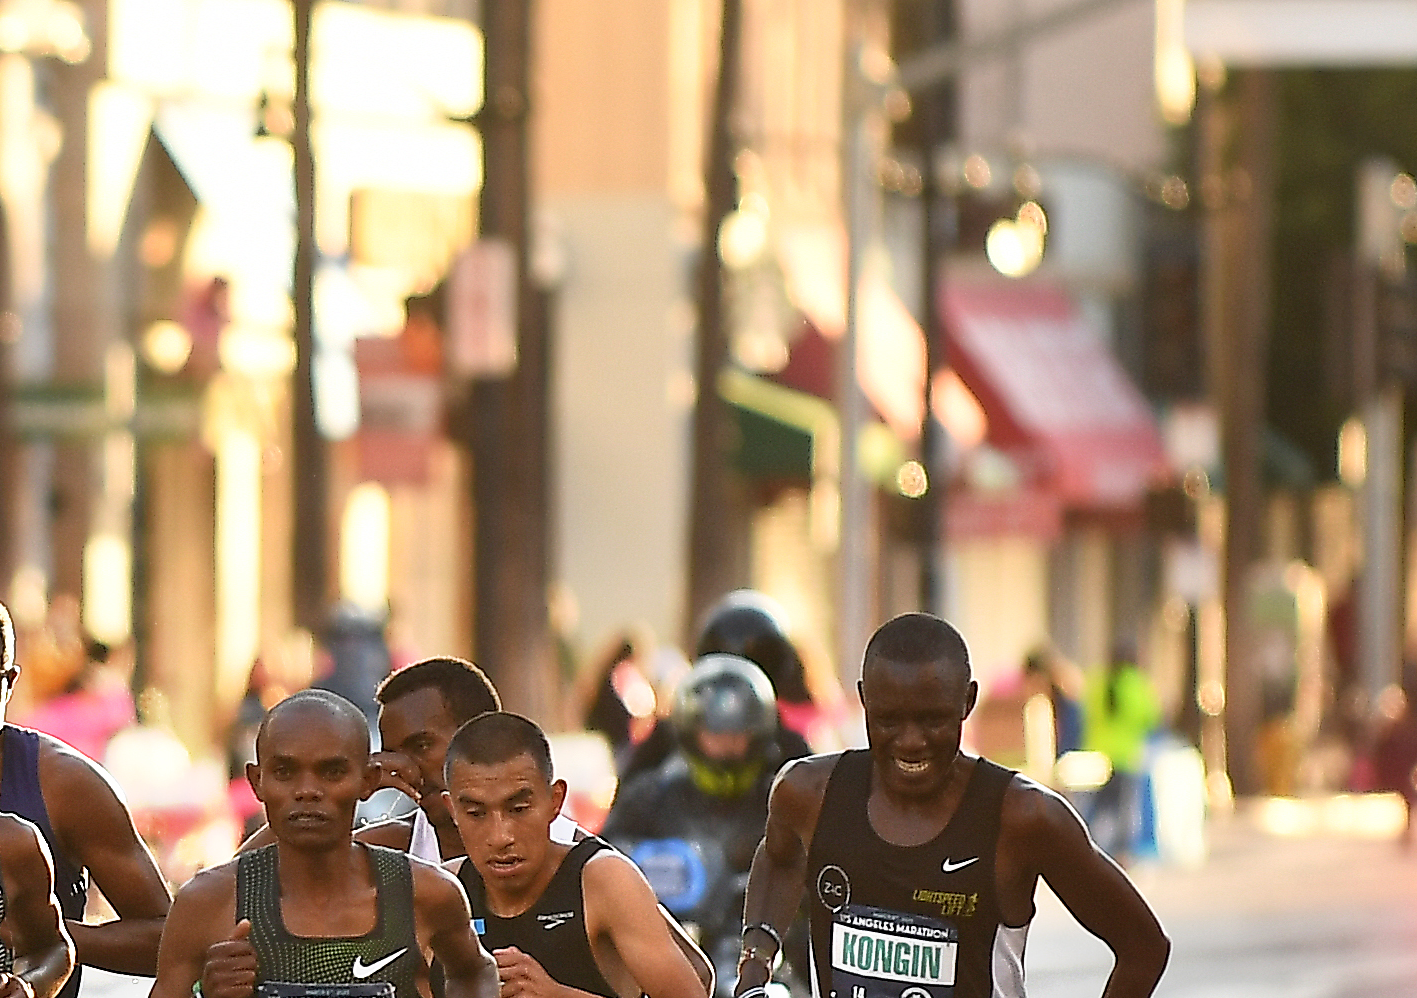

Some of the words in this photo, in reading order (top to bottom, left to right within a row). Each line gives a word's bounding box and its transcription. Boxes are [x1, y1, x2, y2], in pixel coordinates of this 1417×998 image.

[852, 916, 895, 932] ANGELES
[895, 924, 949, 939] MARATHON
[842, 932, 942, 980] KONGIN
